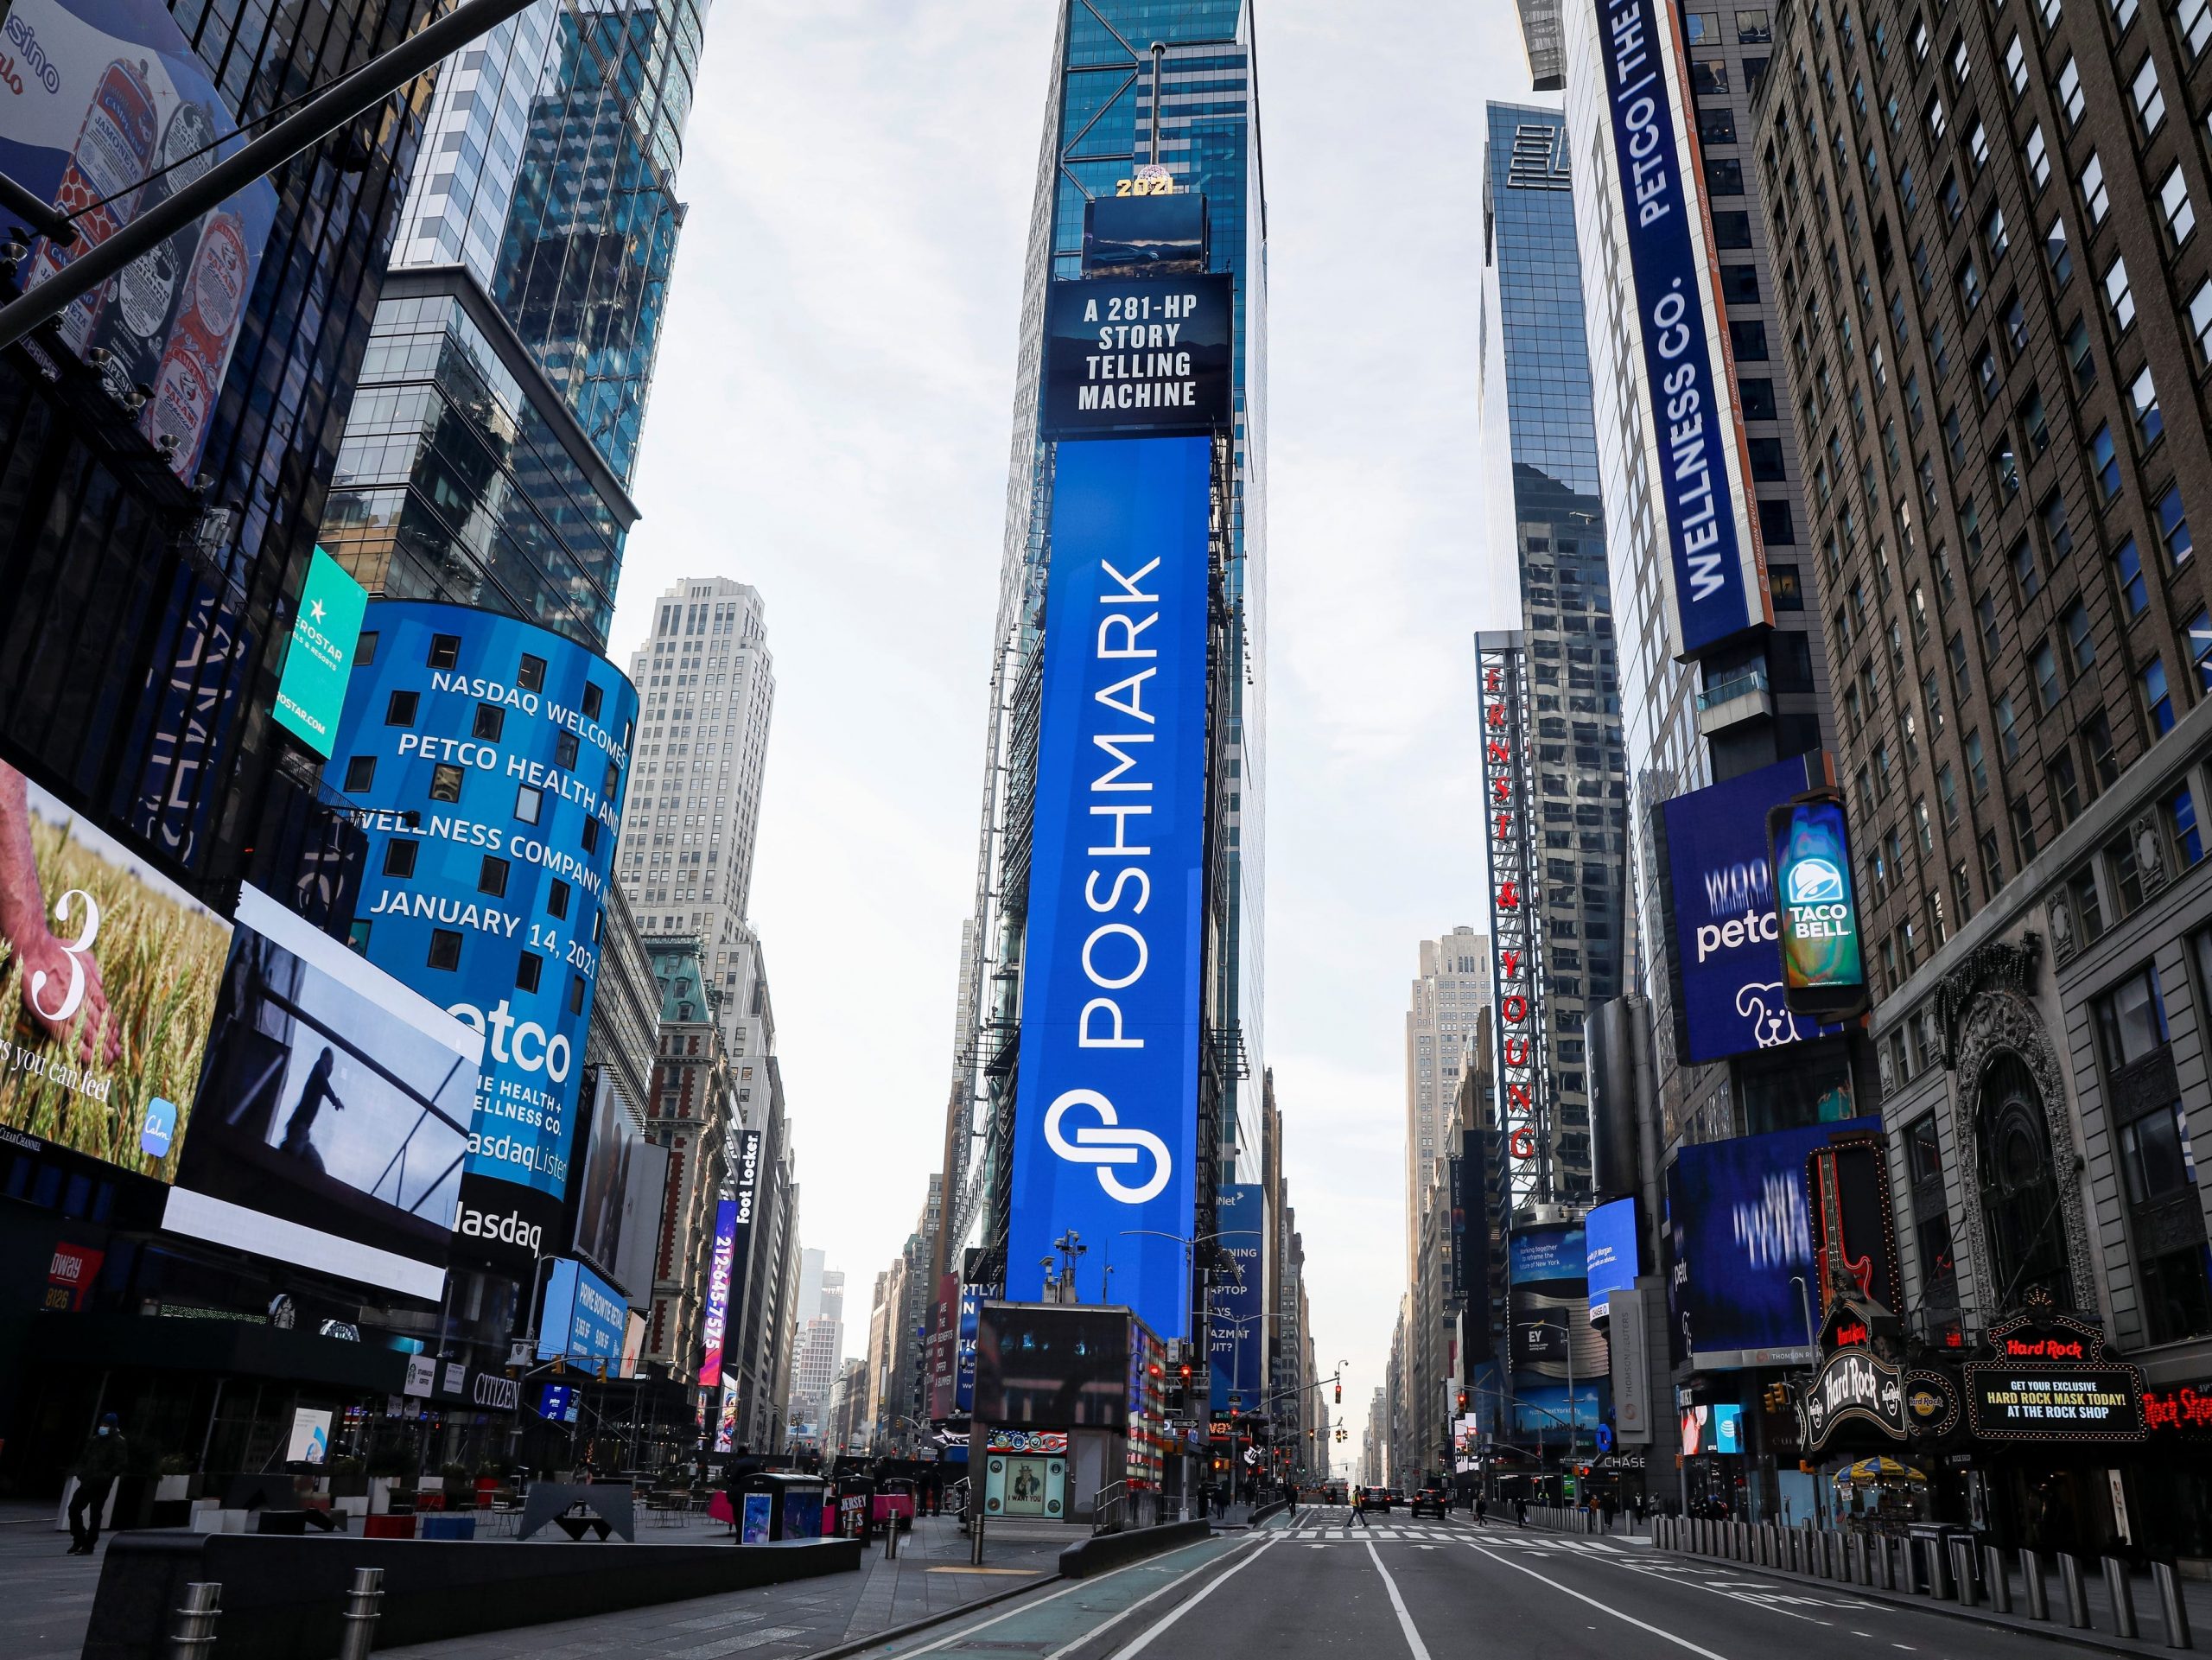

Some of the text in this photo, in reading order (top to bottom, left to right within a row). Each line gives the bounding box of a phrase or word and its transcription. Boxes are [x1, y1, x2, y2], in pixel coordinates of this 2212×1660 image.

[1677, 50, 1692, 115] THOMSON REUTERS
[1611, 1, 1669, 228] PETCO THE
[95, 116, 138, 179] JAMONETA
[1116, 176, 1173, 197] 2021
[1699, 184, 1715, 256] THOMSON REUTERS
[1084, 294, 1197, 322] A 281-HP
[1098, 323, 1180, 350] STORY
[1086, 352, 1191, 379] TELLING
[1722, 329, 1739, 405] THOMSON REUTERS
[1078, 381, 1196, 410] MACHINE
[1655, 277, 1725, 601] WELLNESS CO.
[1746, 487, 1764, 571] THOMSON REUTERS
[311, 646, 337, 671] RESORTS
[431, 672, 627, 770] NASDAQ WELCOMES
[398, 733, 620, 836] PETCO HEALTH AND
[1078, 556, 1160, 1048] POSHMARK
[510, 836, 602, 902] COMPANY,
[1485, 665, 1534, 1161] ERNST & YOUNG
[1789, 904, 1847, 922] TACO
[1796, 920, 1849, 938] BELL
[371, 890, 596, 980] JANUARY 14, 2021
[31, 889, 99, 1021] 3
[11, 1046, 46, 1077] you
[48, 1062, 78, 1090] can
[80, 1070, 111, 1103] feel
[500, 1080, 556, 1112] HEALTH
[144, 1115, 169, 1142] Calm
[473, 1095, 563, 1136] ELLNESS CO.
[736, 1135, 758, 1224] Foot Locker
[1535, 1244, 1557, 1254] together
[45, 1288, 69, 1310] 8126
[580, 1282, 594, 1310] PRIME
[609, 1305, 624, 1331] RETAIL
[705, 1237, 732, 1350] 212-645-7575
[938, 1330, 953, 1342] BENEFITS
[1529, 1331, 1541, 1342] EY
[2007, 1340, 2083, 1359] Hard Rock
[936, 1361, 947, 1372] OFFER
[474, 1372, 522, 1410] CITIZEN
[1825, 1358, 1878, 1414] Hard Rock
[1909, 1396, 1943, 1408] Hard Rock
[1987, 1392, 2126, 1406] HARD ROCK MASK TODAY!
[2011, 1381, 2098, 1392] GET YOUR EXCLUSIVE
[2007, 1406, 2109, 1419] AT THE ROCK SHOP
[2143, 1393, 2181, 1430] Rock
[1605, 1457, 1645, 1468] CHASE
[841, 1494, 866, 1511] JERSEY
